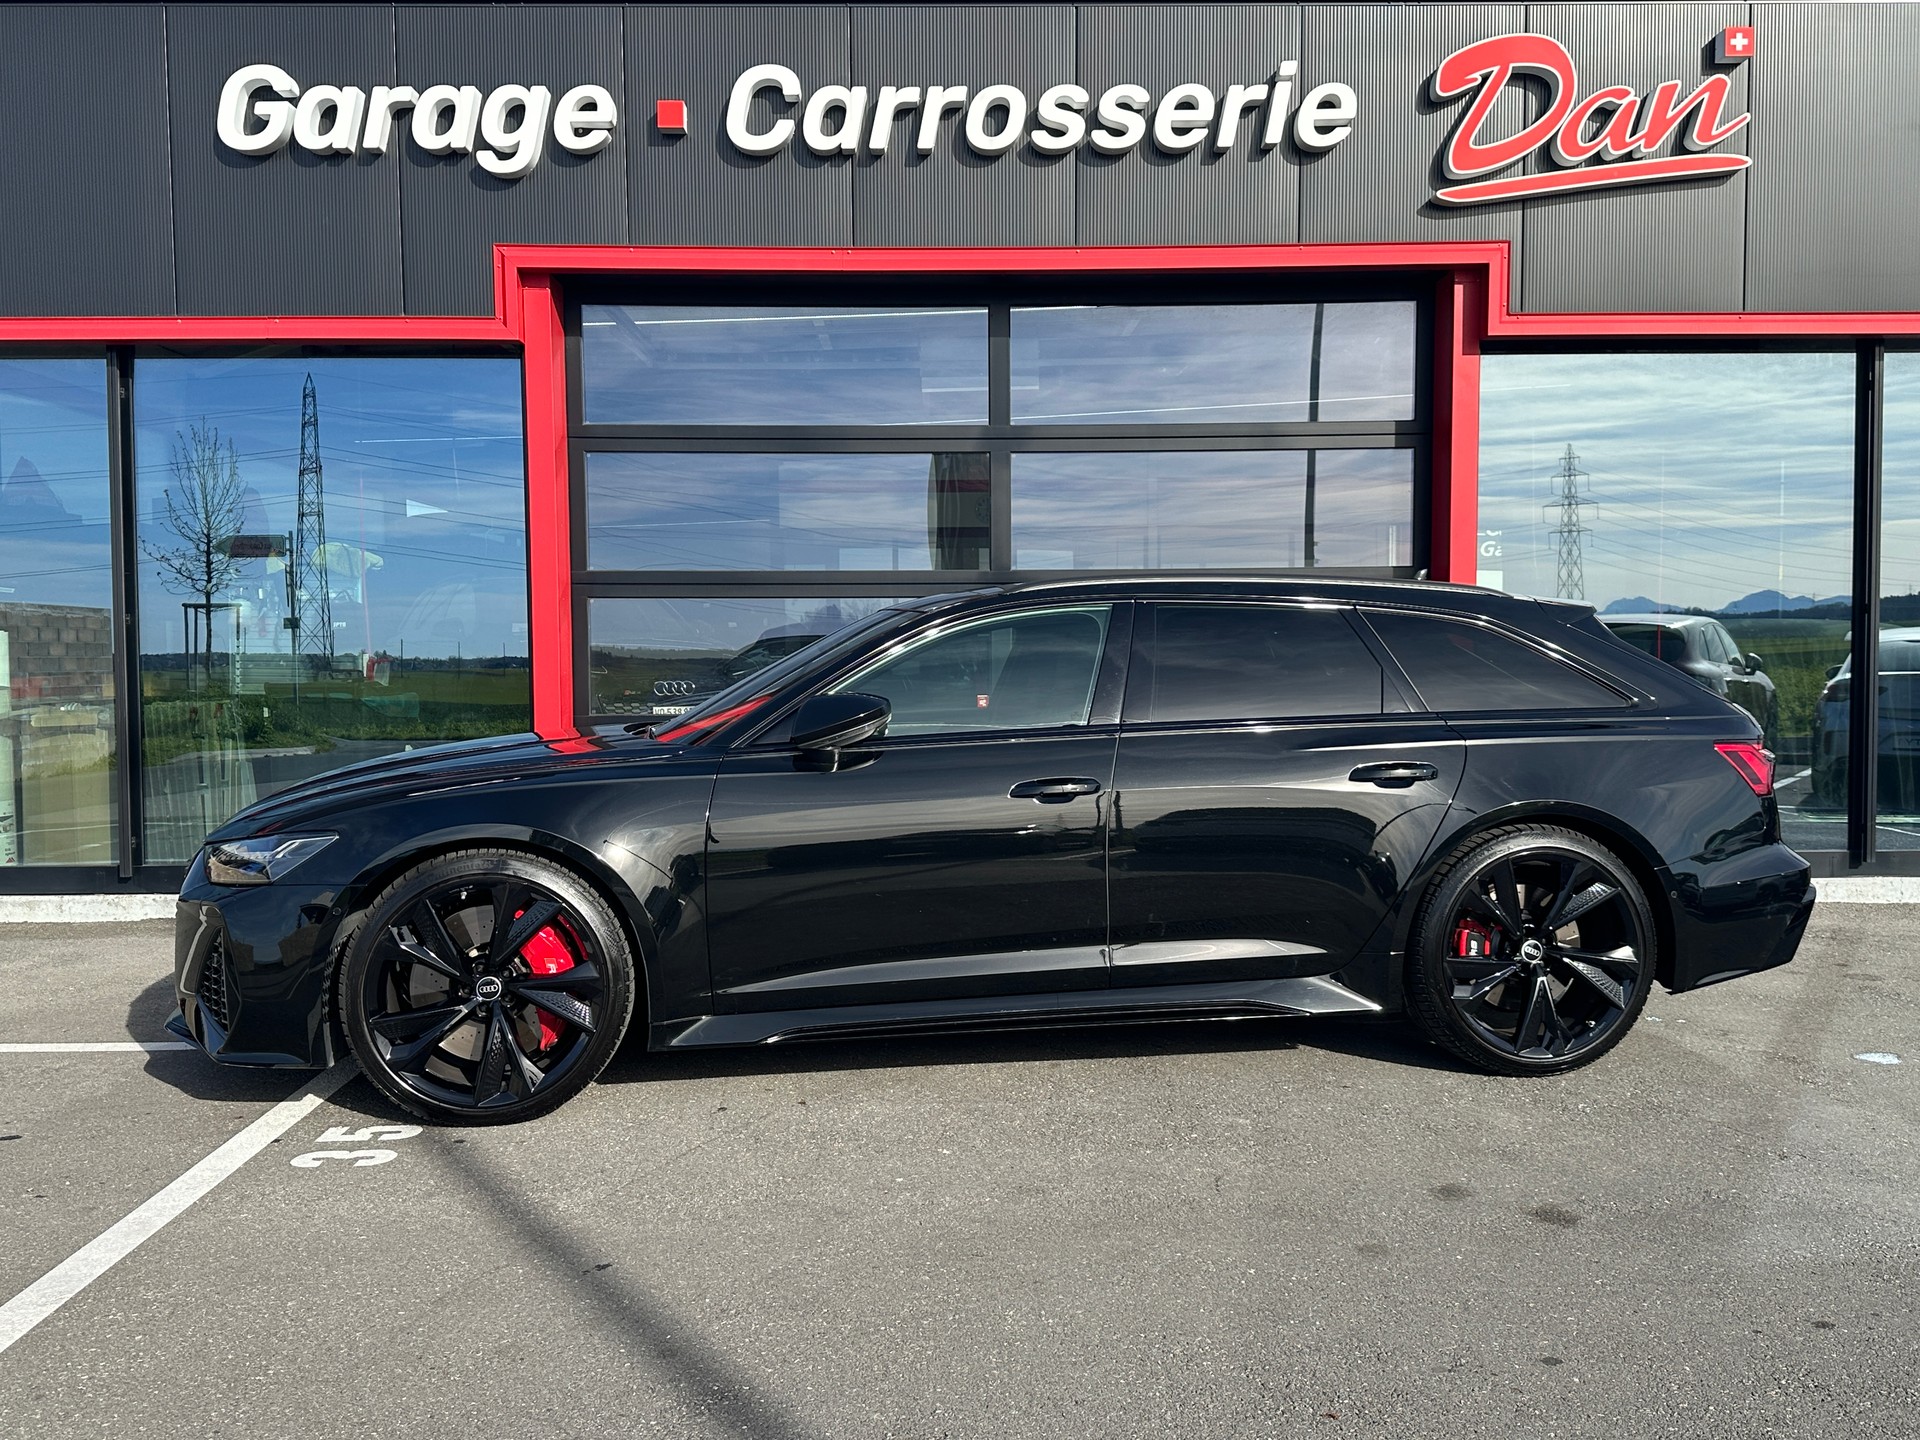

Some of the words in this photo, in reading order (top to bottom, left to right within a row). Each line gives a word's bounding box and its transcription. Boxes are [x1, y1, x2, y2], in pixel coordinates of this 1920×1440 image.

[217, 64, 617, 178] Garage
[725, 60, 1358, 155] Carrosserie
[289, 1124, 424, 1168] 35
